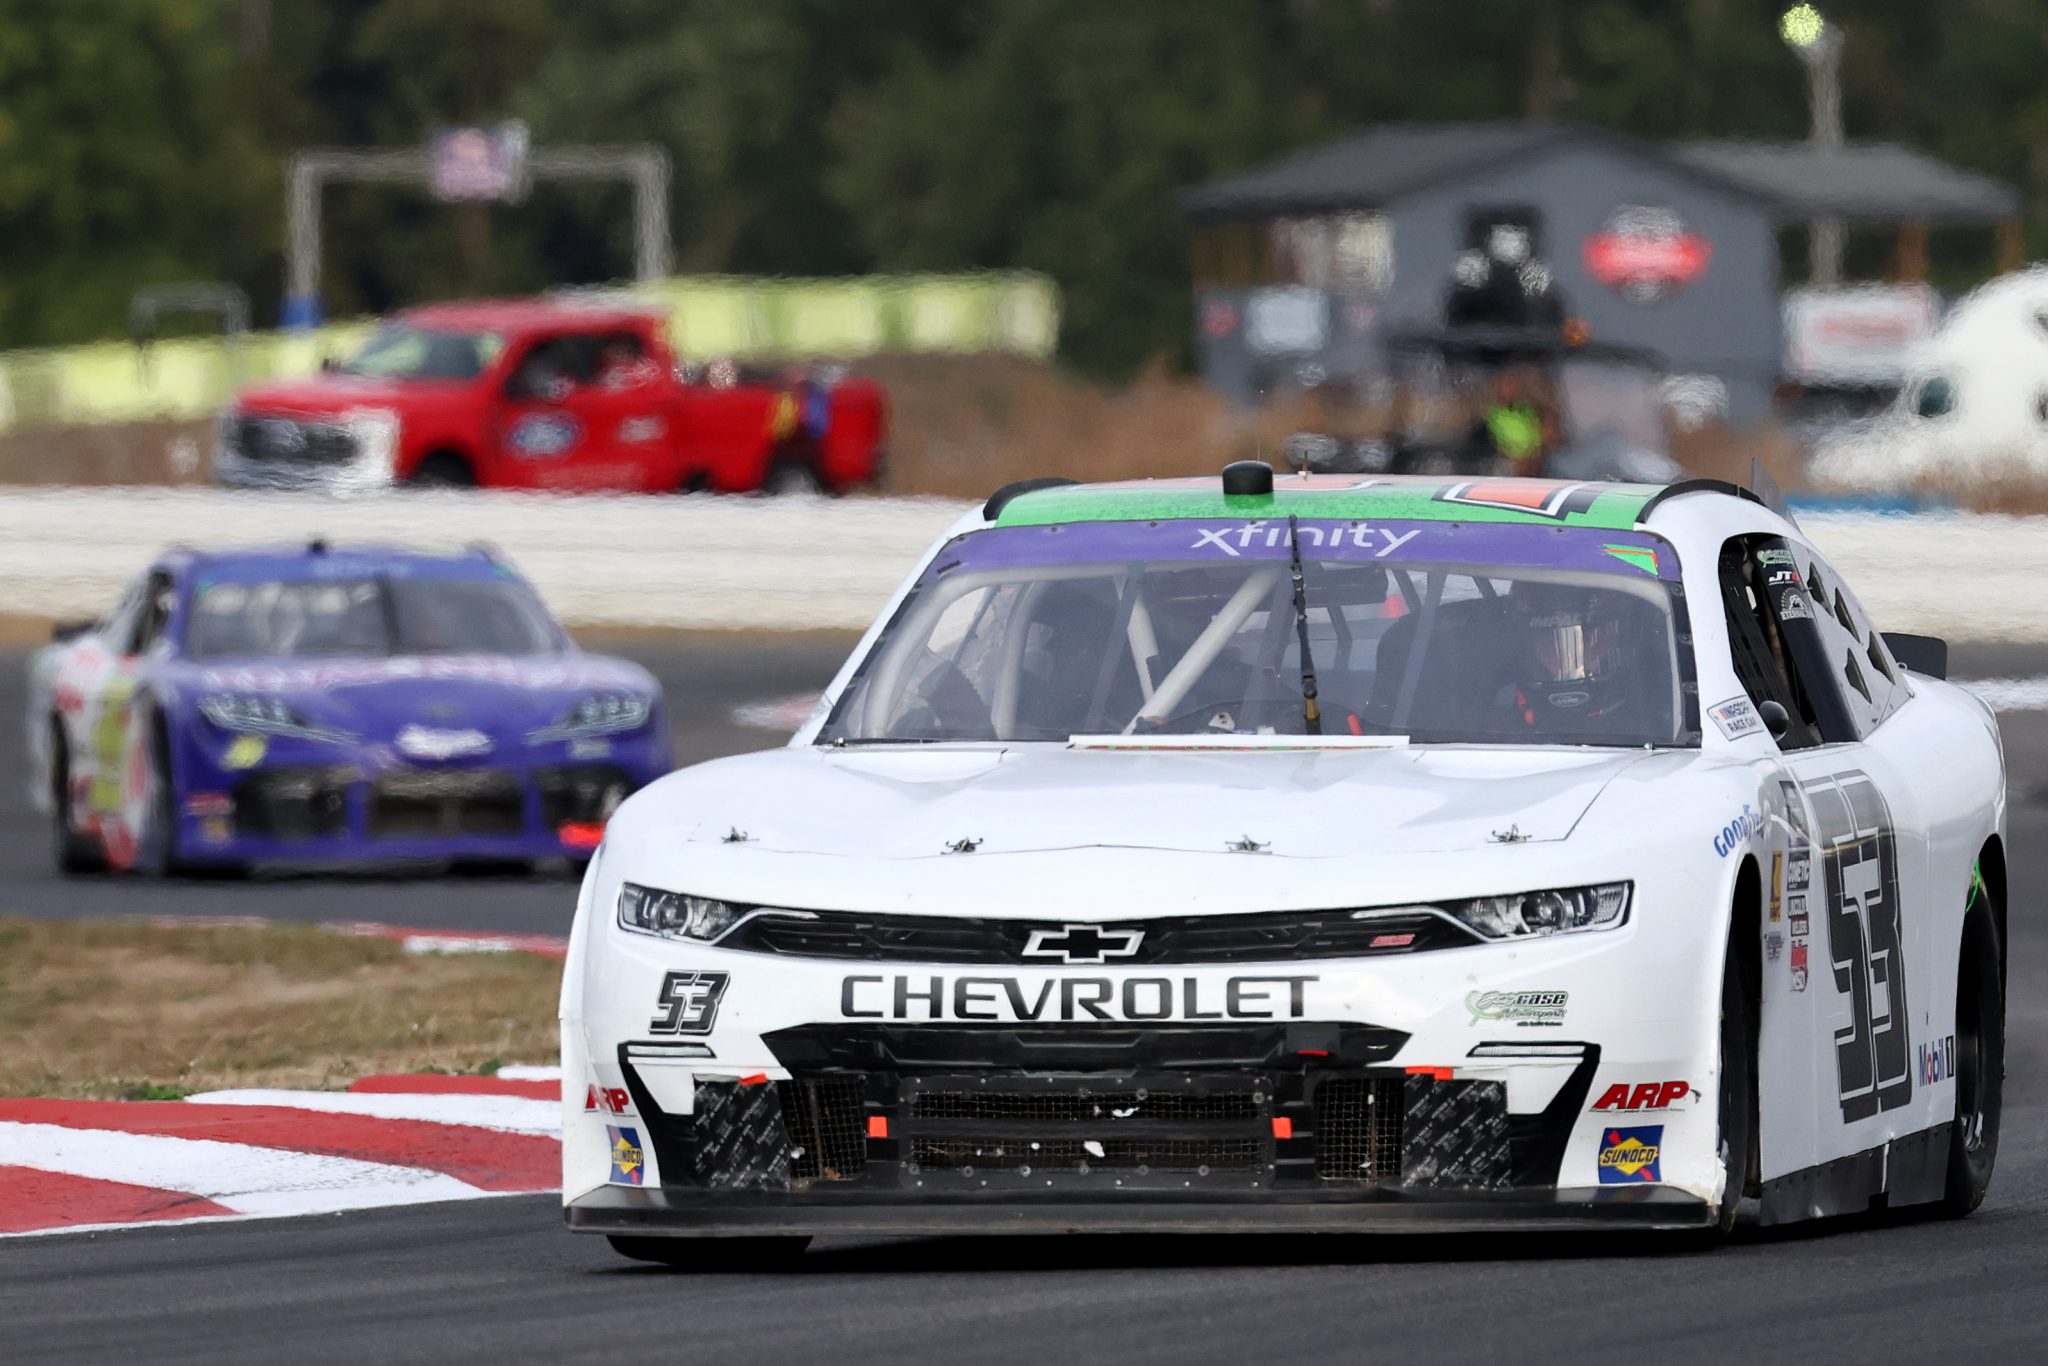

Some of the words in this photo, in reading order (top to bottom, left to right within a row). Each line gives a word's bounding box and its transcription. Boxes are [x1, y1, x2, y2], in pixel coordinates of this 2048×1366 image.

[1190, 520, 1422, 558] xfinity
[1802, 768, 1913, 1124] 53
[648, 969, 731, 1036] 53
[841, 974, 1320, 1021] CHEVROLET
[1919, 1038, 1945, 1087] Mobil
[585, 1083, 630, 1114] ARP
[1592, 1080, 1690, 1110] ARP
[1602, 1147, 1656, 1164] SUNOCO
